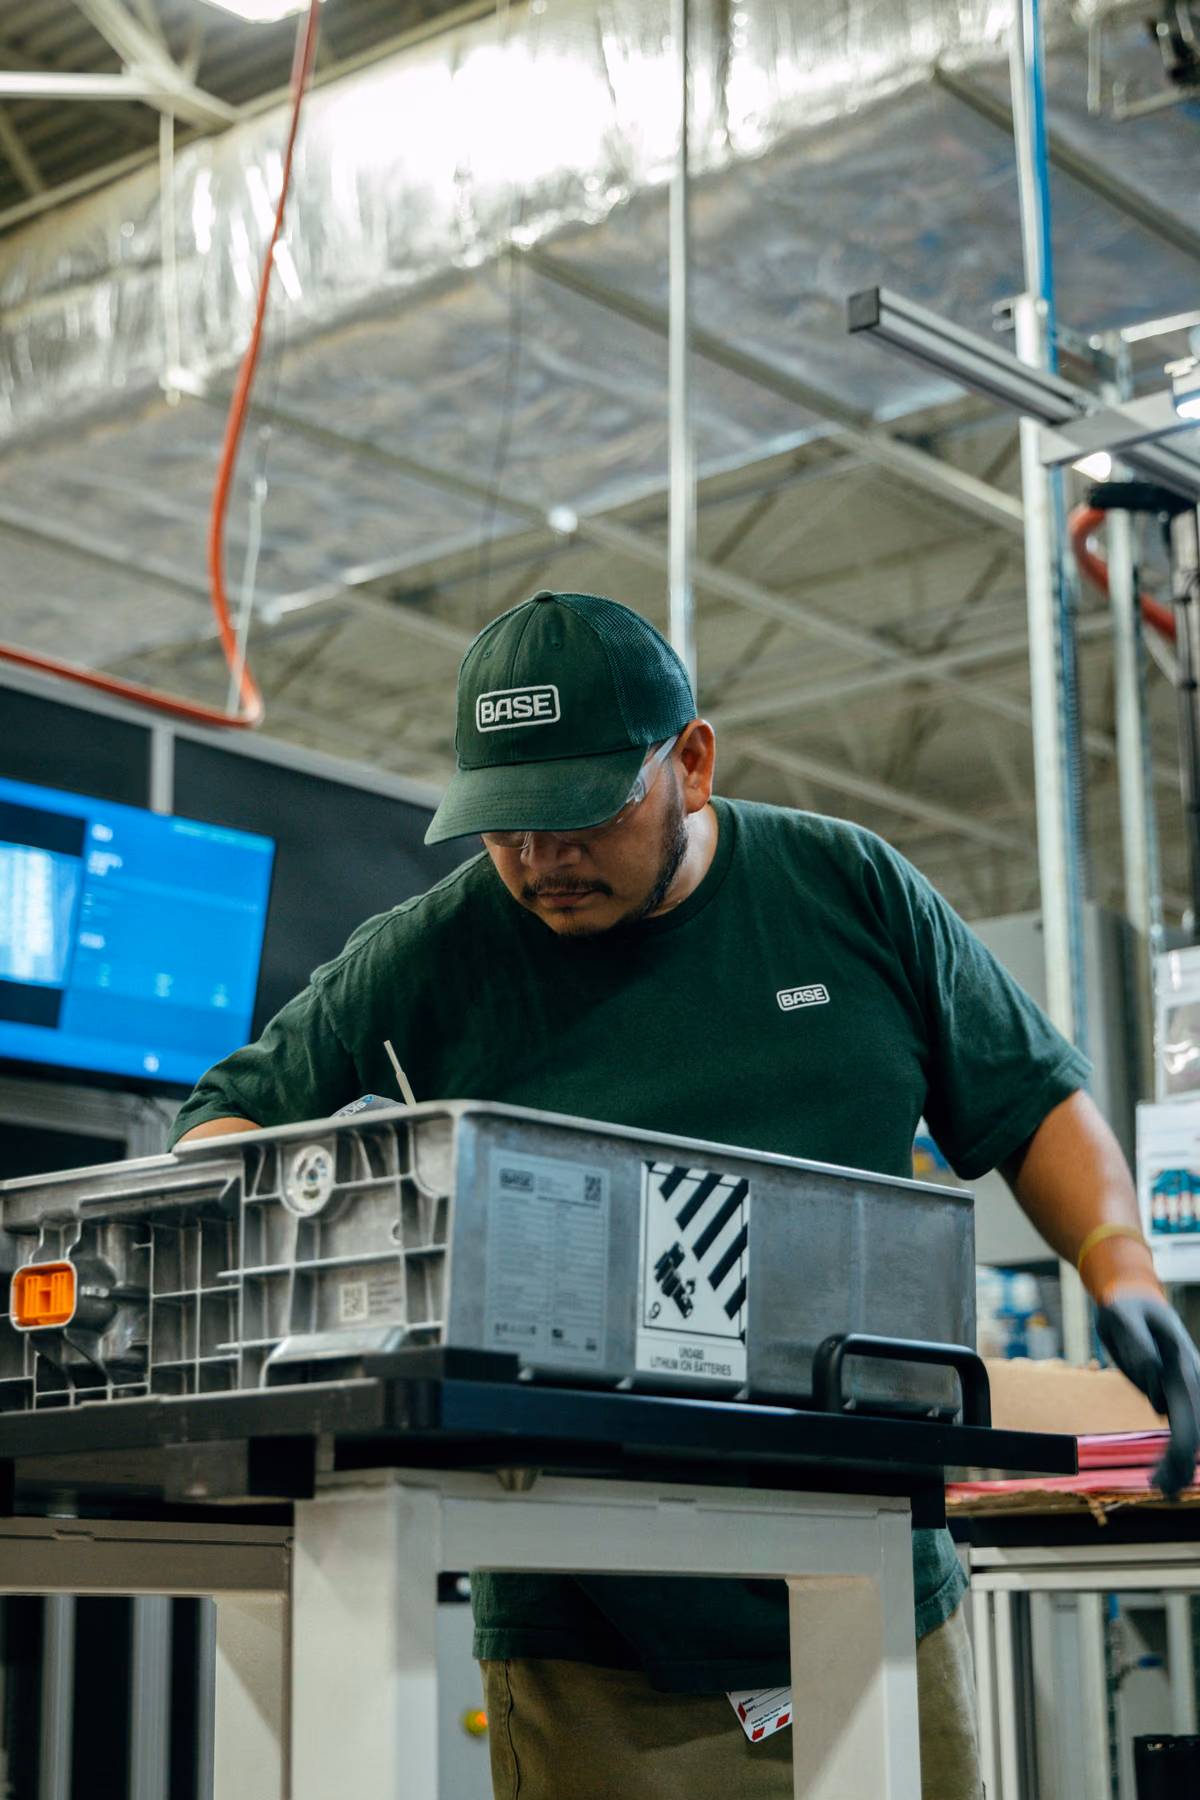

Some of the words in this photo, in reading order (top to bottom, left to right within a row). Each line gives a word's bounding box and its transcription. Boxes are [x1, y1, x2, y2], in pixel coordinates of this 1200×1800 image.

[481, 693, 552, 724] BASE
[781, 988, 825, 1006] BASE
[649, 1301, 661, 1320] 9
[650, 1355, 678, 1369] LITHIUM
[681, 1360, 692, 1371] ION
[694, 1361, 732, 1376] BATTERIES
